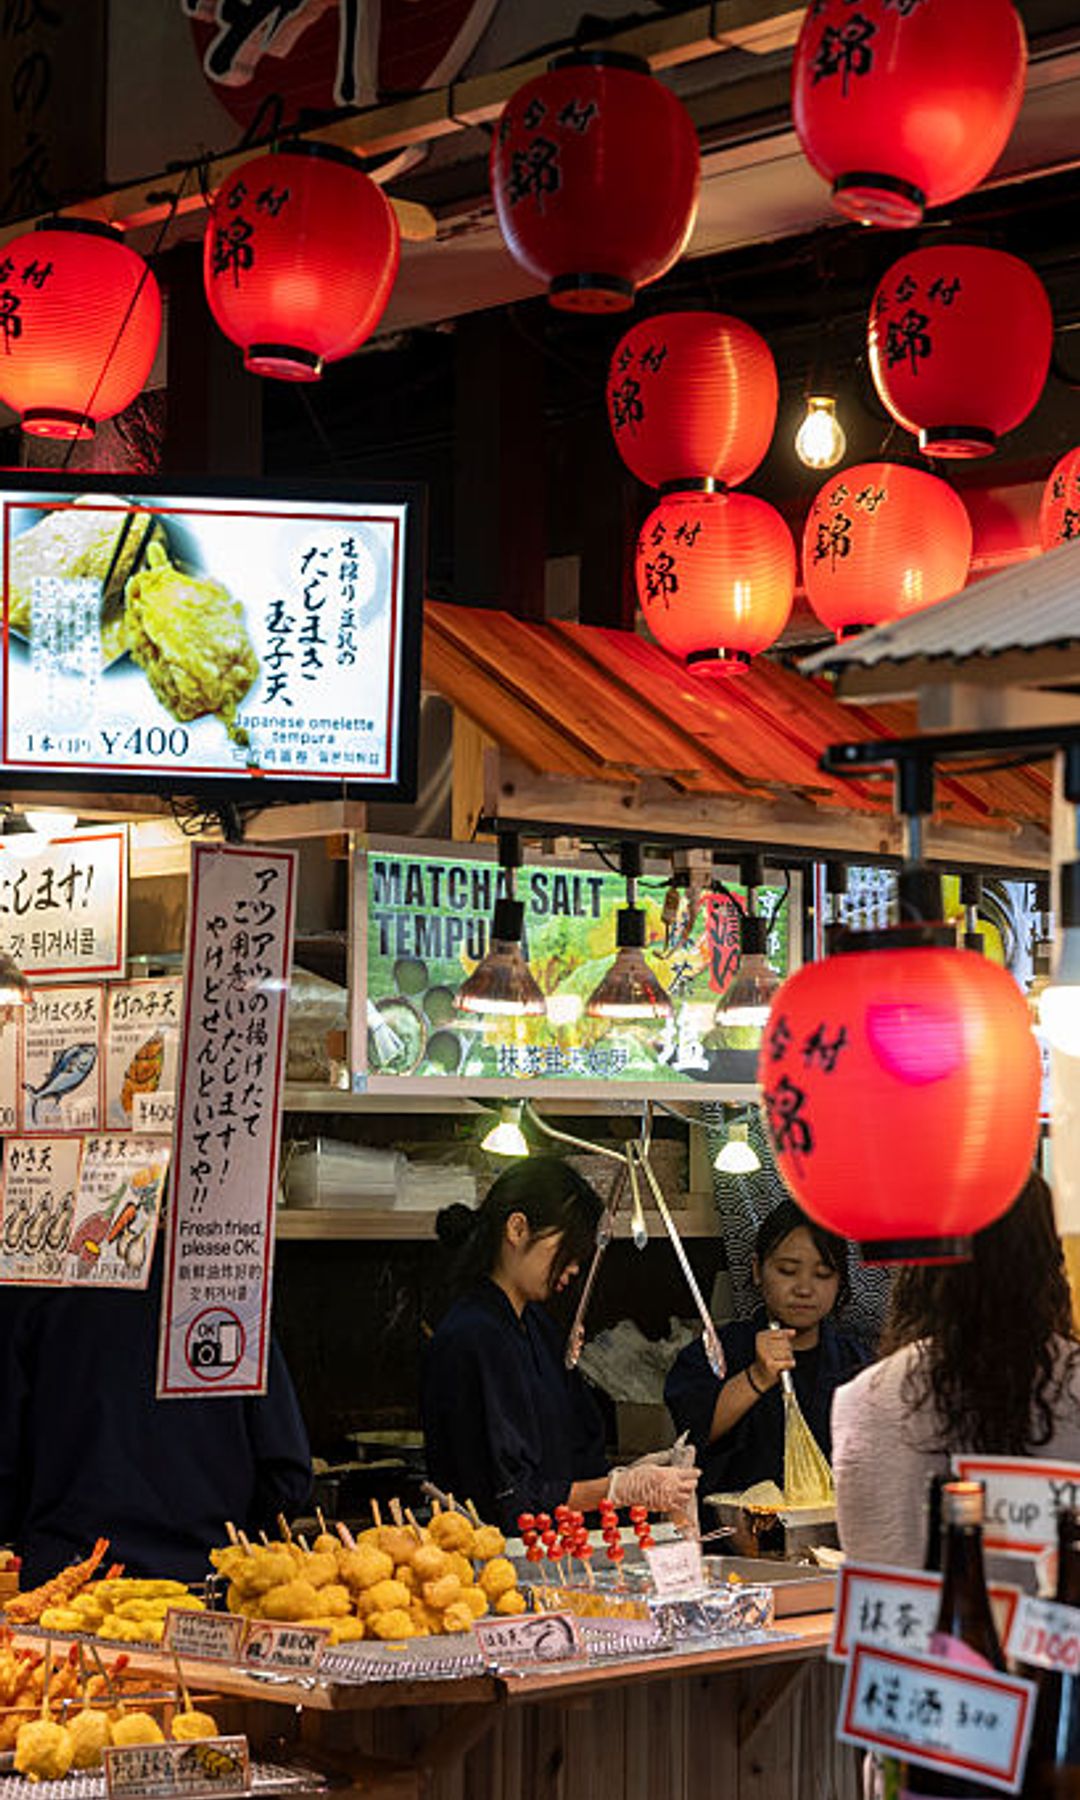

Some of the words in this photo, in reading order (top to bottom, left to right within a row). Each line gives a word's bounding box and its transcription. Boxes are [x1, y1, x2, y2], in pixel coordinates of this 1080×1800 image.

[297, 546, 334, 681] だしまき
[260, 598, 298, 708] 玉子天
[235, 713, 306, 731] Japanese
[308, 715, 375, 732] omelette
[271, 730, 336, 745] tempura
[529, 871, 604, 919] SALT
[180, 1220, 222, 1237] Fresh
[181, 1241, 231, 1258] please
[198, 1323, 215, 1338] OK
